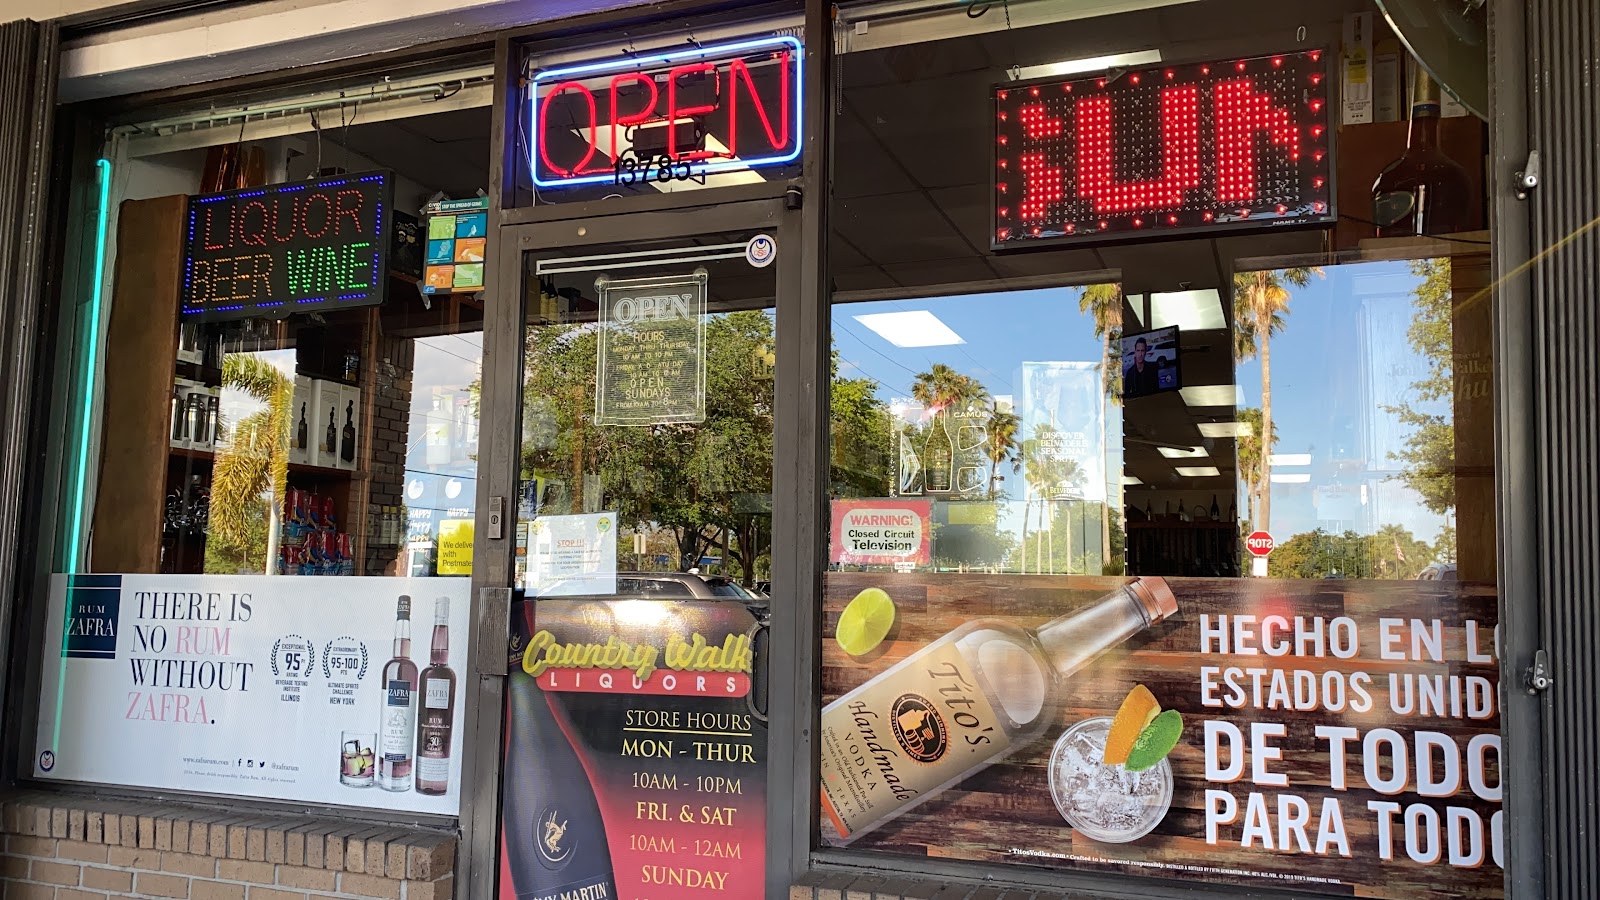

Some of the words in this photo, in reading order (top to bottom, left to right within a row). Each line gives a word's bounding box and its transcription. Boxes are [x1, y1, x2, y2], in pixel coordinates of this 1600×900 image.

[540, 51, 789, 178] OPEN
[613, 153, 691, 187] 13785
[204, 189, 364, 250] LIQUOR
[191, 253, 274, 304] BEER
[287, 242, 370, 295] WINE
[613, 293, 693, 325] OPEN
[633, 330, 665, 343] HOURS
[625, 387, 671, 400] SUNDAYS
[630, 377, 664, 388] OPEN
[1042, 432, 1085, 440] DISCOVER
[409, 508, 432, 519] HAPPY
[850, 514, 913, 526] WARNING!
[557, 539, 574, 547] STOP
[848, 530, 880, 538] Closed
[884, 530, 914, 538] Circuit
[852, 540, 912, 550] Television
[442, 550, 457, 558] with
[442, 559, 473, 567] Postmate
[78, 604, 106, 614] RUM
[134, 592, 222, 621] THERE
[228, 592, 252, 622] IS
[66, 618, 115, 637] ZAFRA
[1200, 614, 1360, 659] HECHO
[1379, 618, 1445, 663] EN
[1465, 619, 1500, 664] L
[131, 624, 167, 654] NO
[175, 626, 232, 656] RUM
[286, 652, 301, 671] 95
[331, 656, 358, 670] 95-100
[522, 630, 658, 681] Country
[664, 632, 752, 674] Walk
[130, 658, 254, 692] WITHOUT
[550, 672, 736, 693] LIQUORS
[280, 694, 300, 702] ILLINOIS
[342, 697, 356, 706] YORK
[388, 688, 409, 697] ZAFRA
[928, 662, 993, 746] Tito's
[1200, 666, 1374, 714] ESTADOS
[1389, 672, 1501, 720] UNID
[125, 691, 215, 725] ZAFRA.
[626, 710, 680, 728] STORE
[687, 712, 751, 731] HOURS
[620, 738, 673, 759] MON
[692, 742, 757, 764] THUR
[844, 732, 877, 791] VODKA
[848, 701, 919, 801] Handmade
[1204, 720, 1288, 787] DE
[632, 772, 678, 791] 10AM
[696, 776, 743, 795] 10PM
[636, 801, 673, 822] FRI.
[679, 804, 696, 824] &
[700, 806, 737, 827] SAT
[836, 786, 857, 819] TEXAS
[1204, 788, 1352, 858] PARA
[630, 834, 676, 854] 10AM
[694, 840, 742, 860] 12AM
[1012, 848, 1066, 860] TitosVodka.com
[1070, 854, 1091, 862] Crafted
[642, 864, 730, 891] SUNDAY
